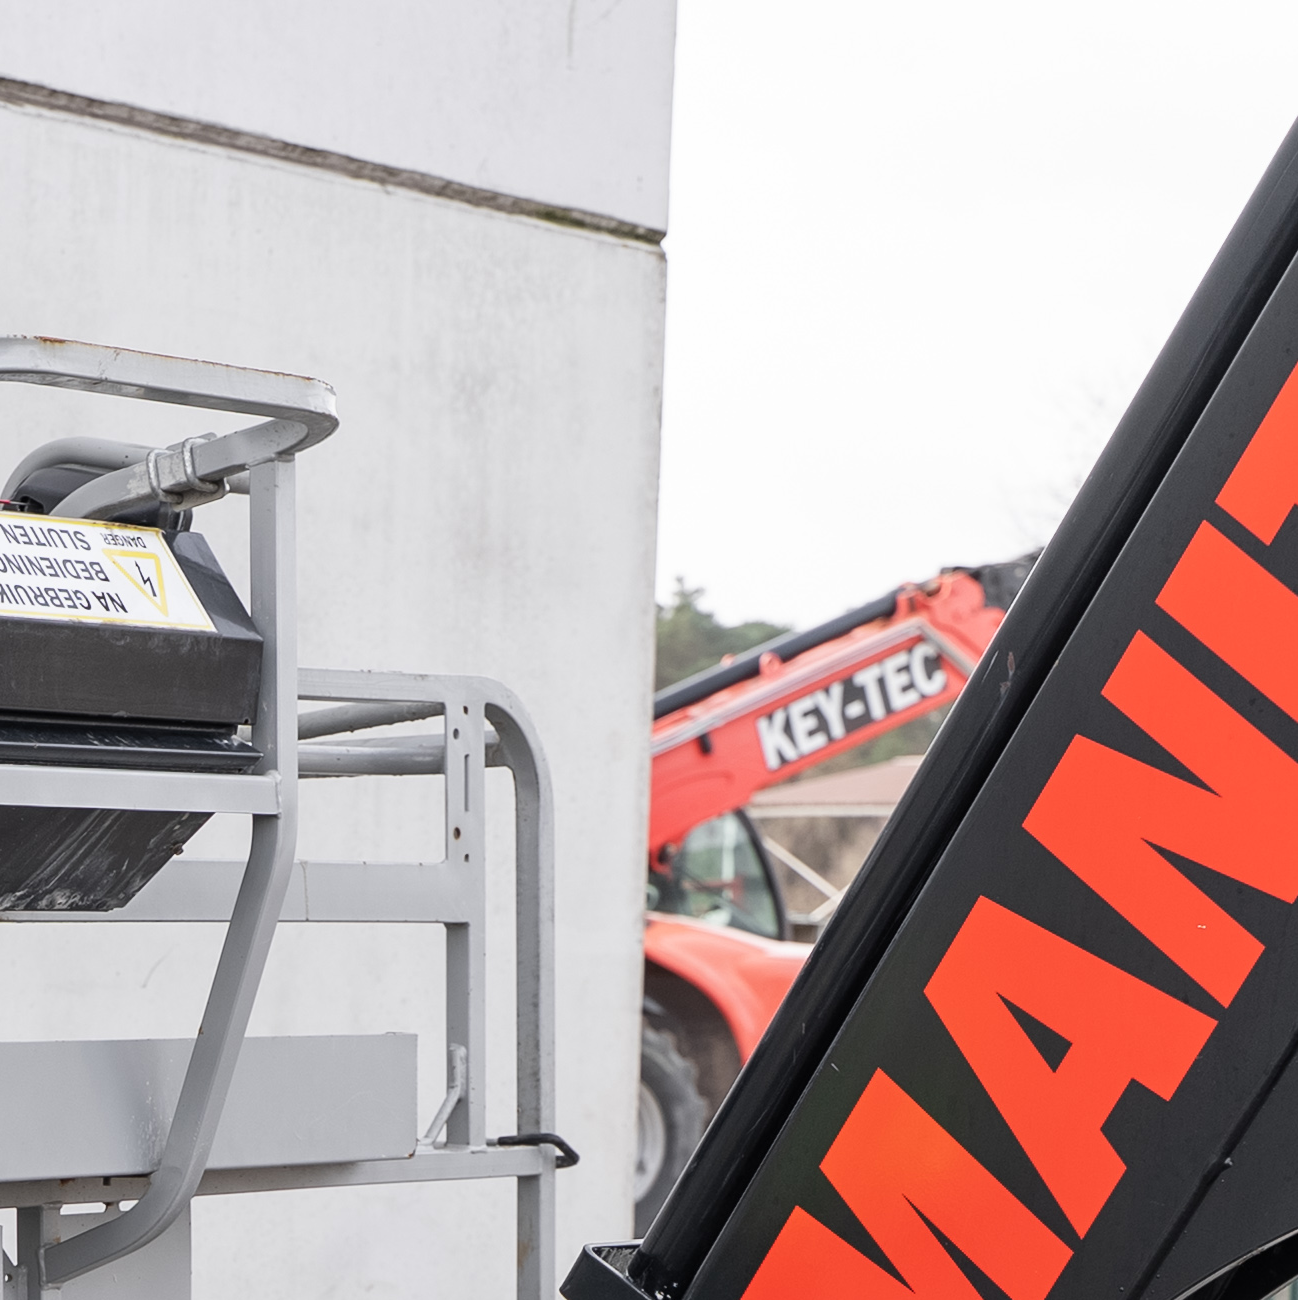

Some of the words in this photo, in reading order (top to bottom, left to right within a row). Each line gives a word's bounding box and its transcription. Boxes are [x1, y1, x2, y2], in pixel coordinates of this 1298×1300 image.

[0, 523, 92, 551] SLUITEN
[100, 532, 147, 549] DANGER
[92, 591, 128, 613] NA
[757, 641, 948, 771] KEY-TEC
